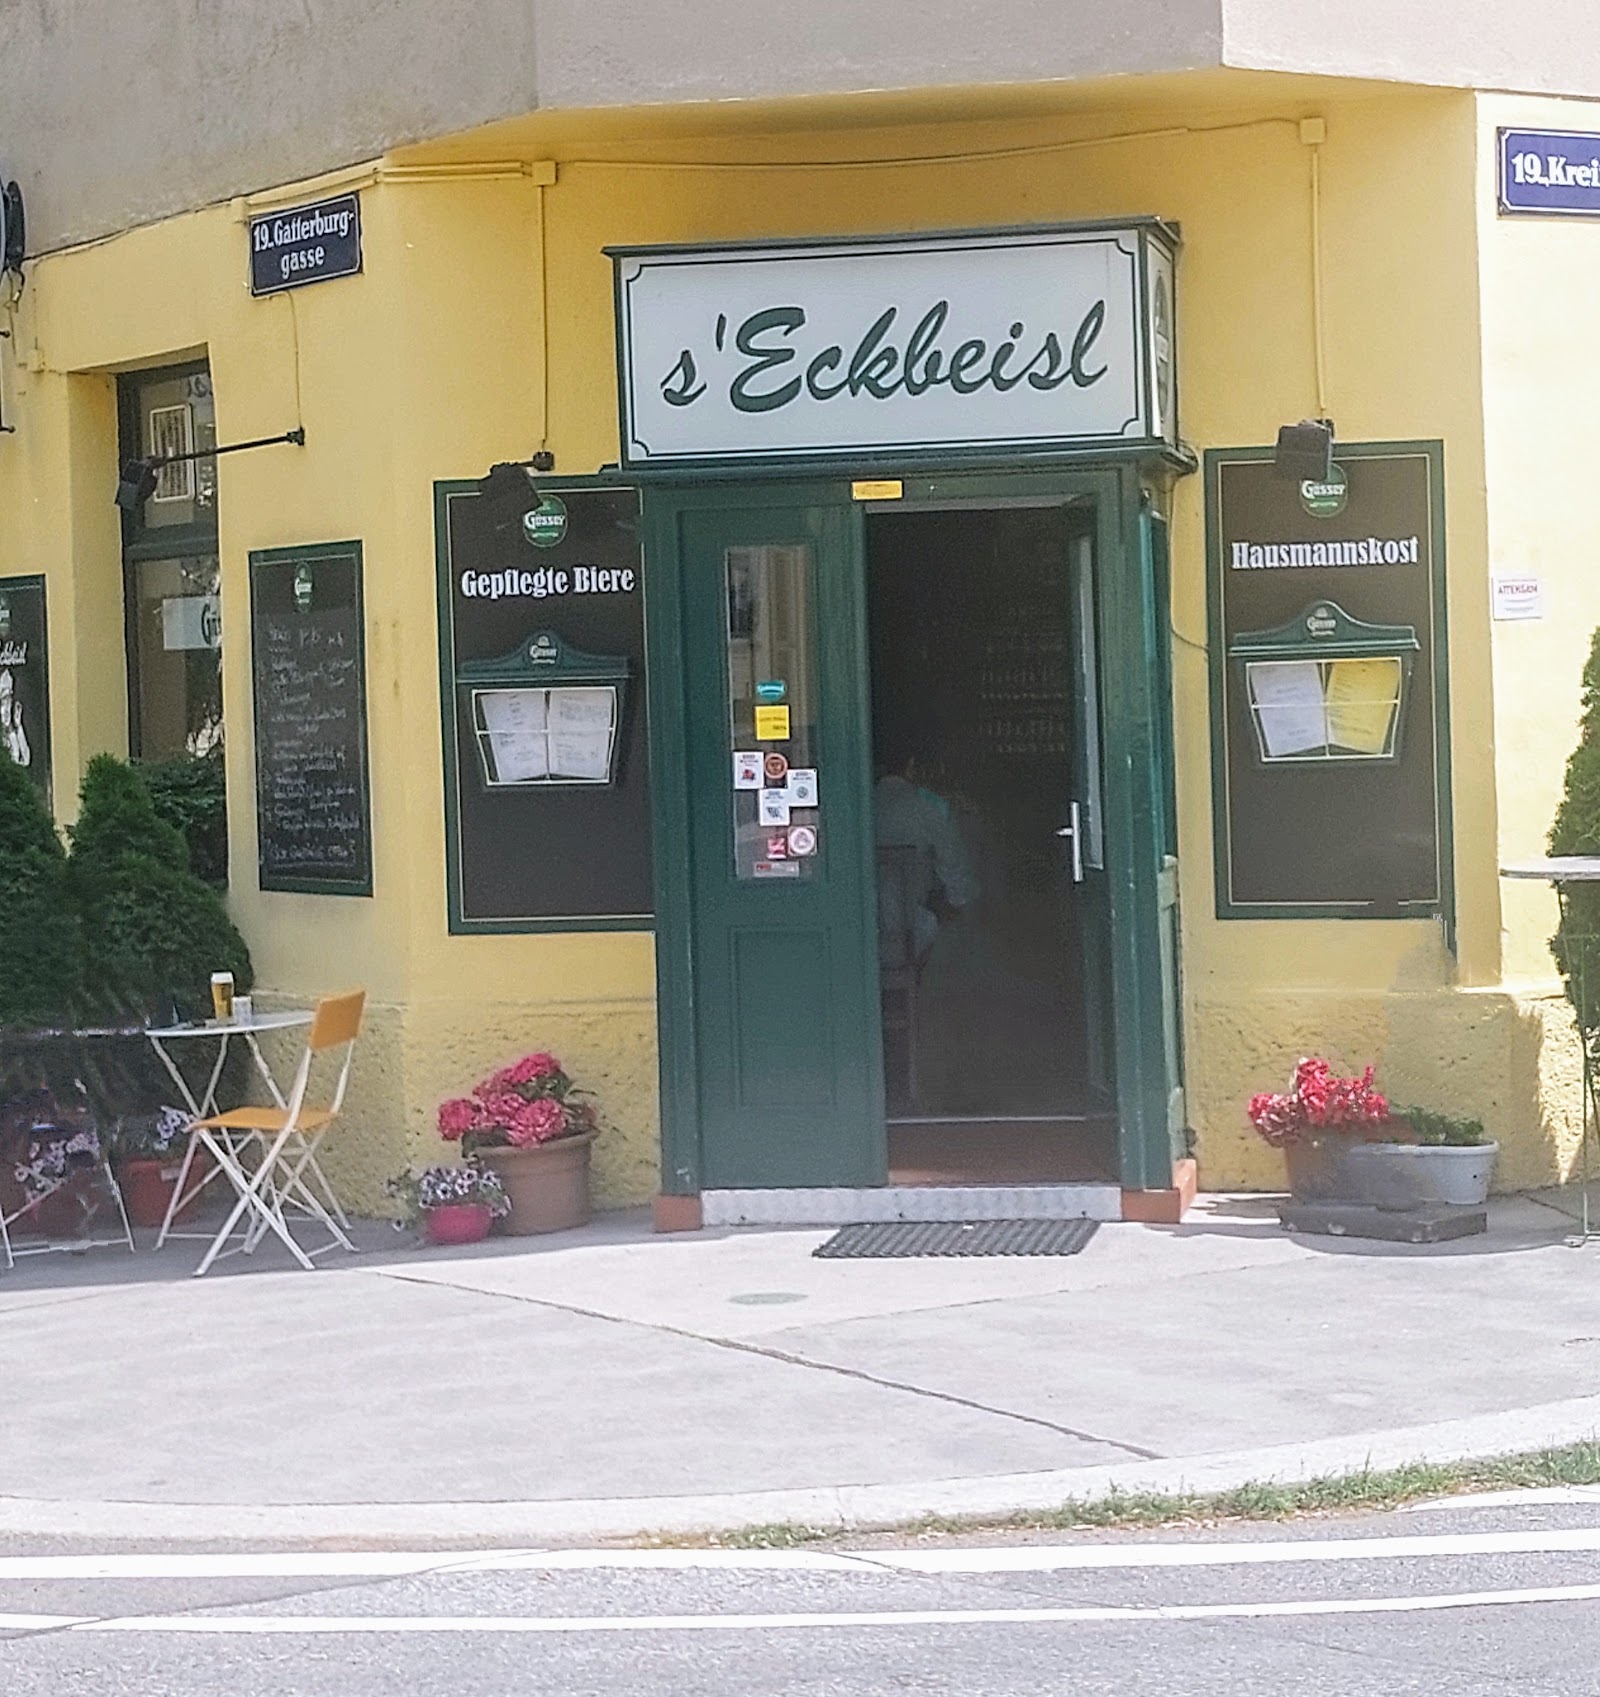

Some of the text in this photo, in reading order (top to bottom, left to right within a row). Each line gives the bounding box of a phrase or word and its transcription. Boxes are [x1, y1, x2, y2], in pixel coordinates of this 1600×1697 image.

[281, 246, 325, 279] gasse
[660, 300, 1107, 413] s'Eckbeisl
[1231, 536, 1418, 570] Hausmannskost
[461, 565, 635, 600] Gepflegte Biere
